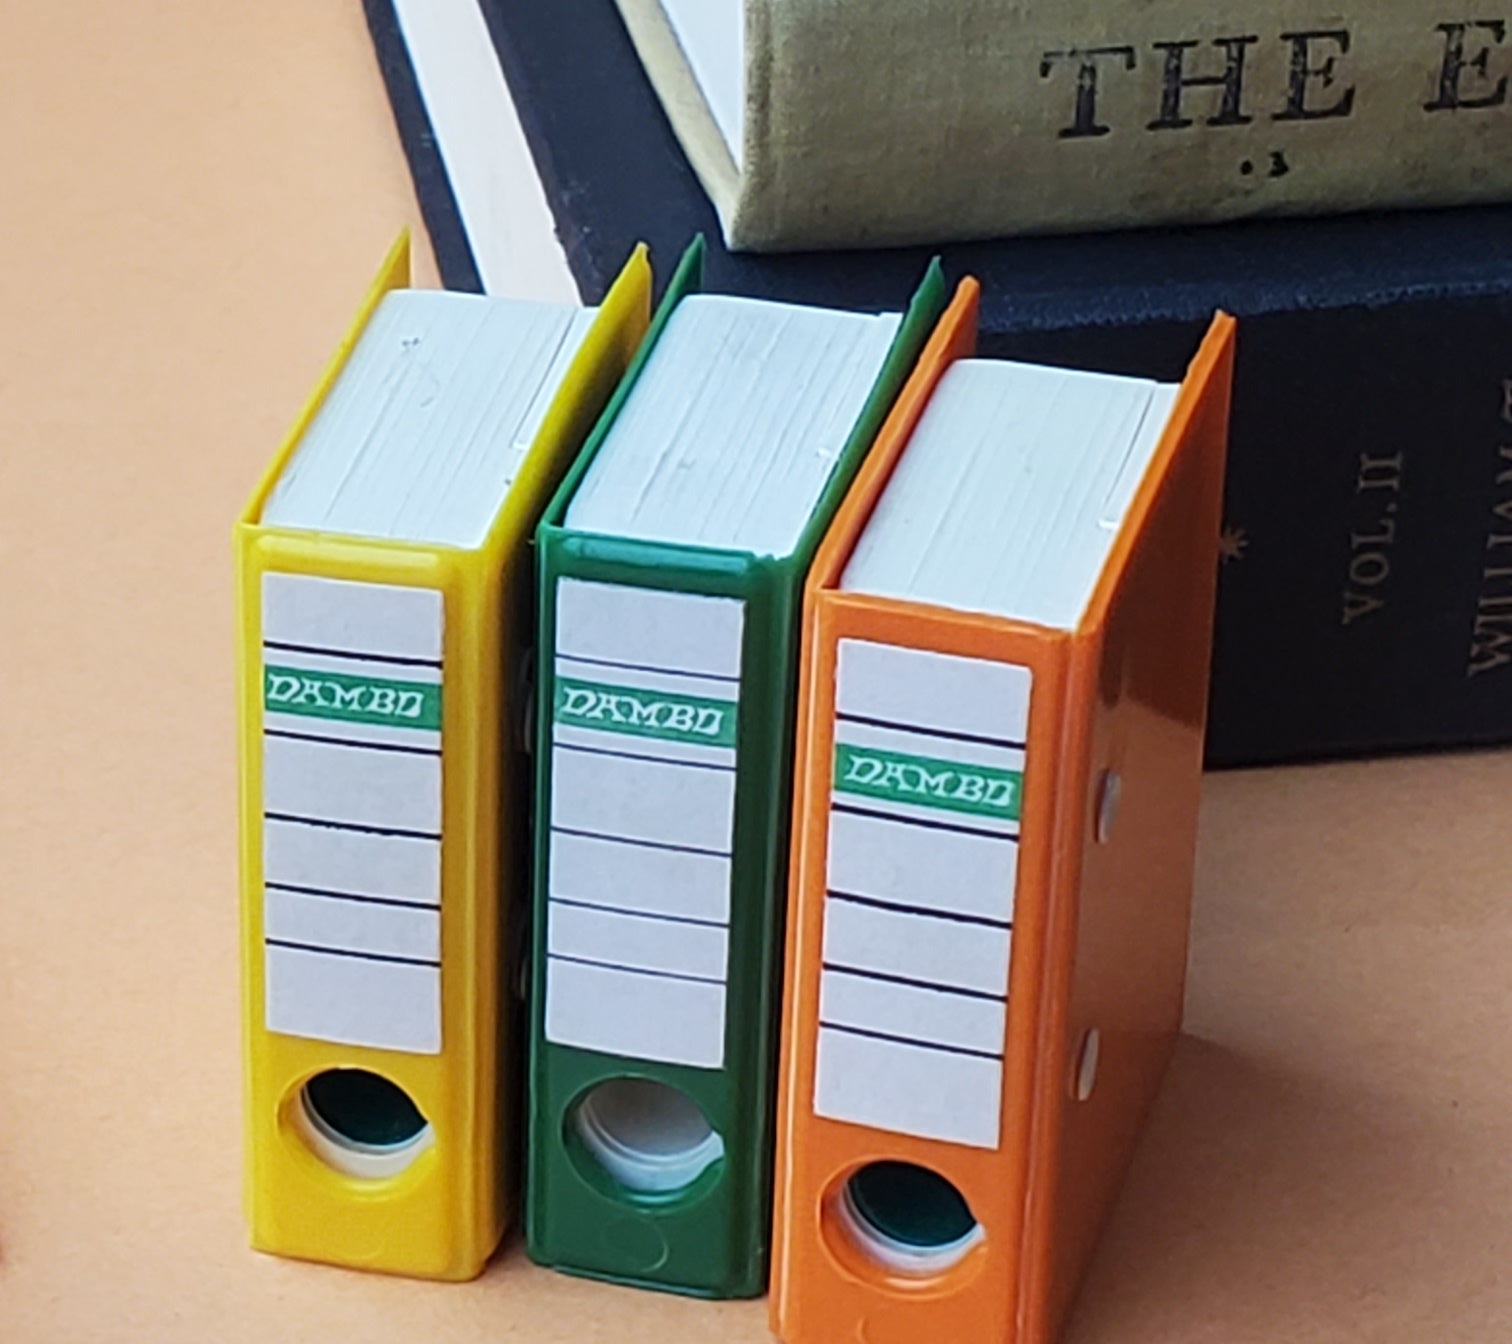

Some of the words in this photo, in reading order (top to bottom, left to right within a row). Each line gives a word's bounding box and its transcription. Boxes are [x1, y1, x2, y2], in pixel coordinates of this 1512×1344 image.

[1039, 28, 1356, 140] THE
[267, 673, 425, 718] DAMBO
[560, 686, 724, 736] DAMBO
[844, 754, 1016, 807] DAMBO
